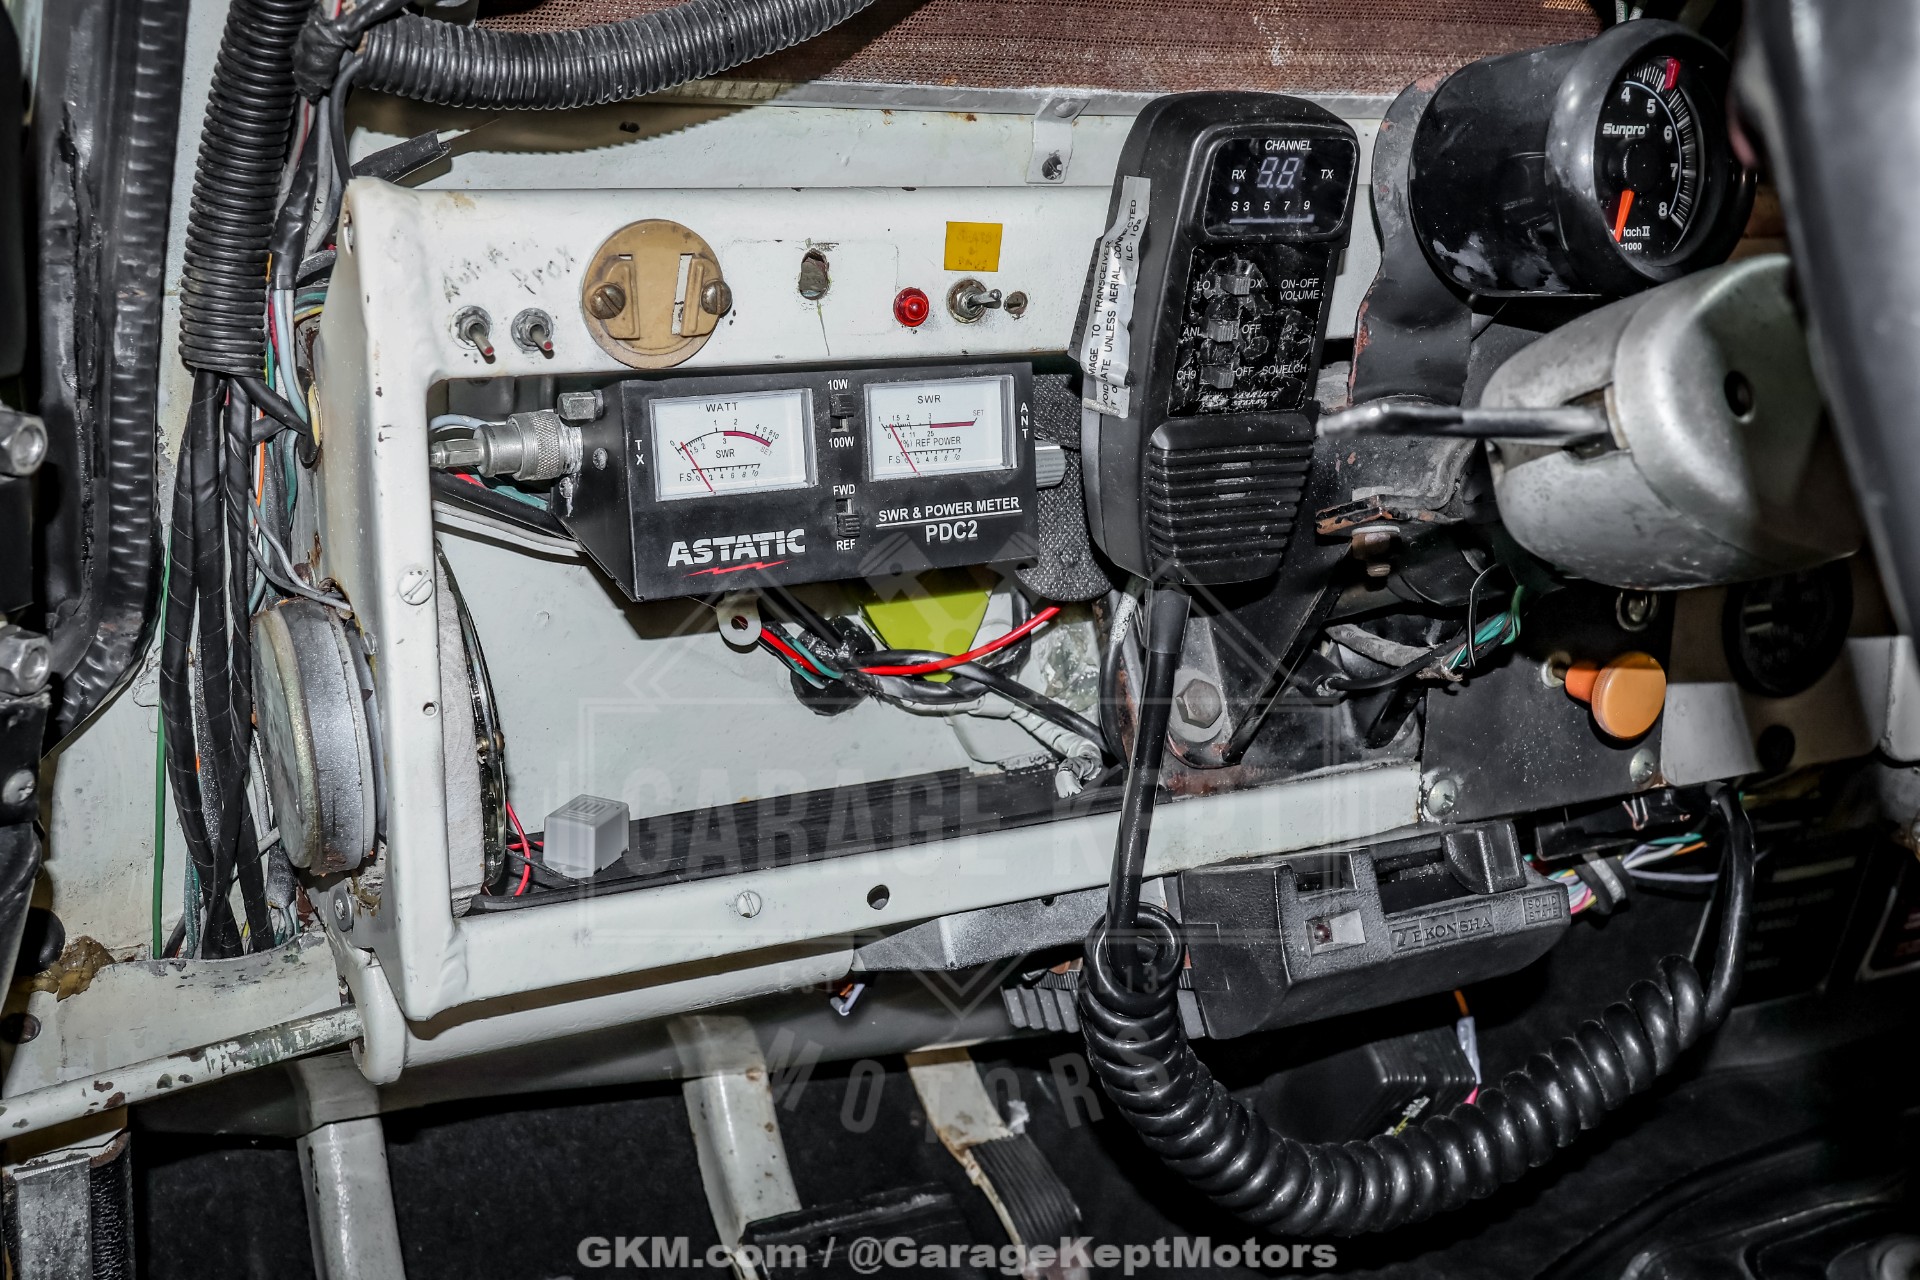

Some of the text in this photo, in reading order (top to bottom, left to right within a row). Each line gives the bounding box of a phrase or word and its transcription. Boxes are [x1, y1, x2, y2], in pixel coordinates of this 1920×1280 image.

[1621, 87, 1630, 102] 4
[1647, 99, 1656, 113] 5
[1603, 122, 1646, 138] Sunpro
[1664, 126, 1672, 140] 6
[1265, 140, 1312, 151] CHANNEL
[1231, 169, 1247, 180] RX
[1320, 169, 1334, 179] TX
[1670, 163, 1678, 177] 7
[1231, 200, 1310, 211] S 3 5 7 9
[1658, 202, 1668, 217] 8
[1109, 266, 1121, 304] AERIAL
[1281, 278, 1319, 288] ON-OFF
[1280, 290, 1319, 300] VOLUME
[1092, 324, 1101, 338] TO
[1105, 310, 1116, 352] UNLESS
[1241, 324, 1261, 334] OFF
[1090, 348, 1099, 375] MAGE
[1235, 367, 1254, 377] OFF
[827, 379, 848, 390] 10W
[917, 395, 941, 404] SWR
[706, 402, 738, 412] WATT
[828, 436, 855, 449] 100W
[916, 438, 930, 447] REF
[934, 436, 961, 446] POWER
[715, 449, 735, 459] SWR
[833, 484, 856, 496] FWD
[878, 497, 1020, 522] SWR & POWER METER
[925, 520, 978, 543] PDC2
[667, 528, 806, 567] ASTATIC
[836, 539, 856, 551] REF
[1527, 896, 1557, 909] SOLID
[1529, 909, 1557, 921] STATE
[1391, 917, 1492, 947] TEKONSHA
